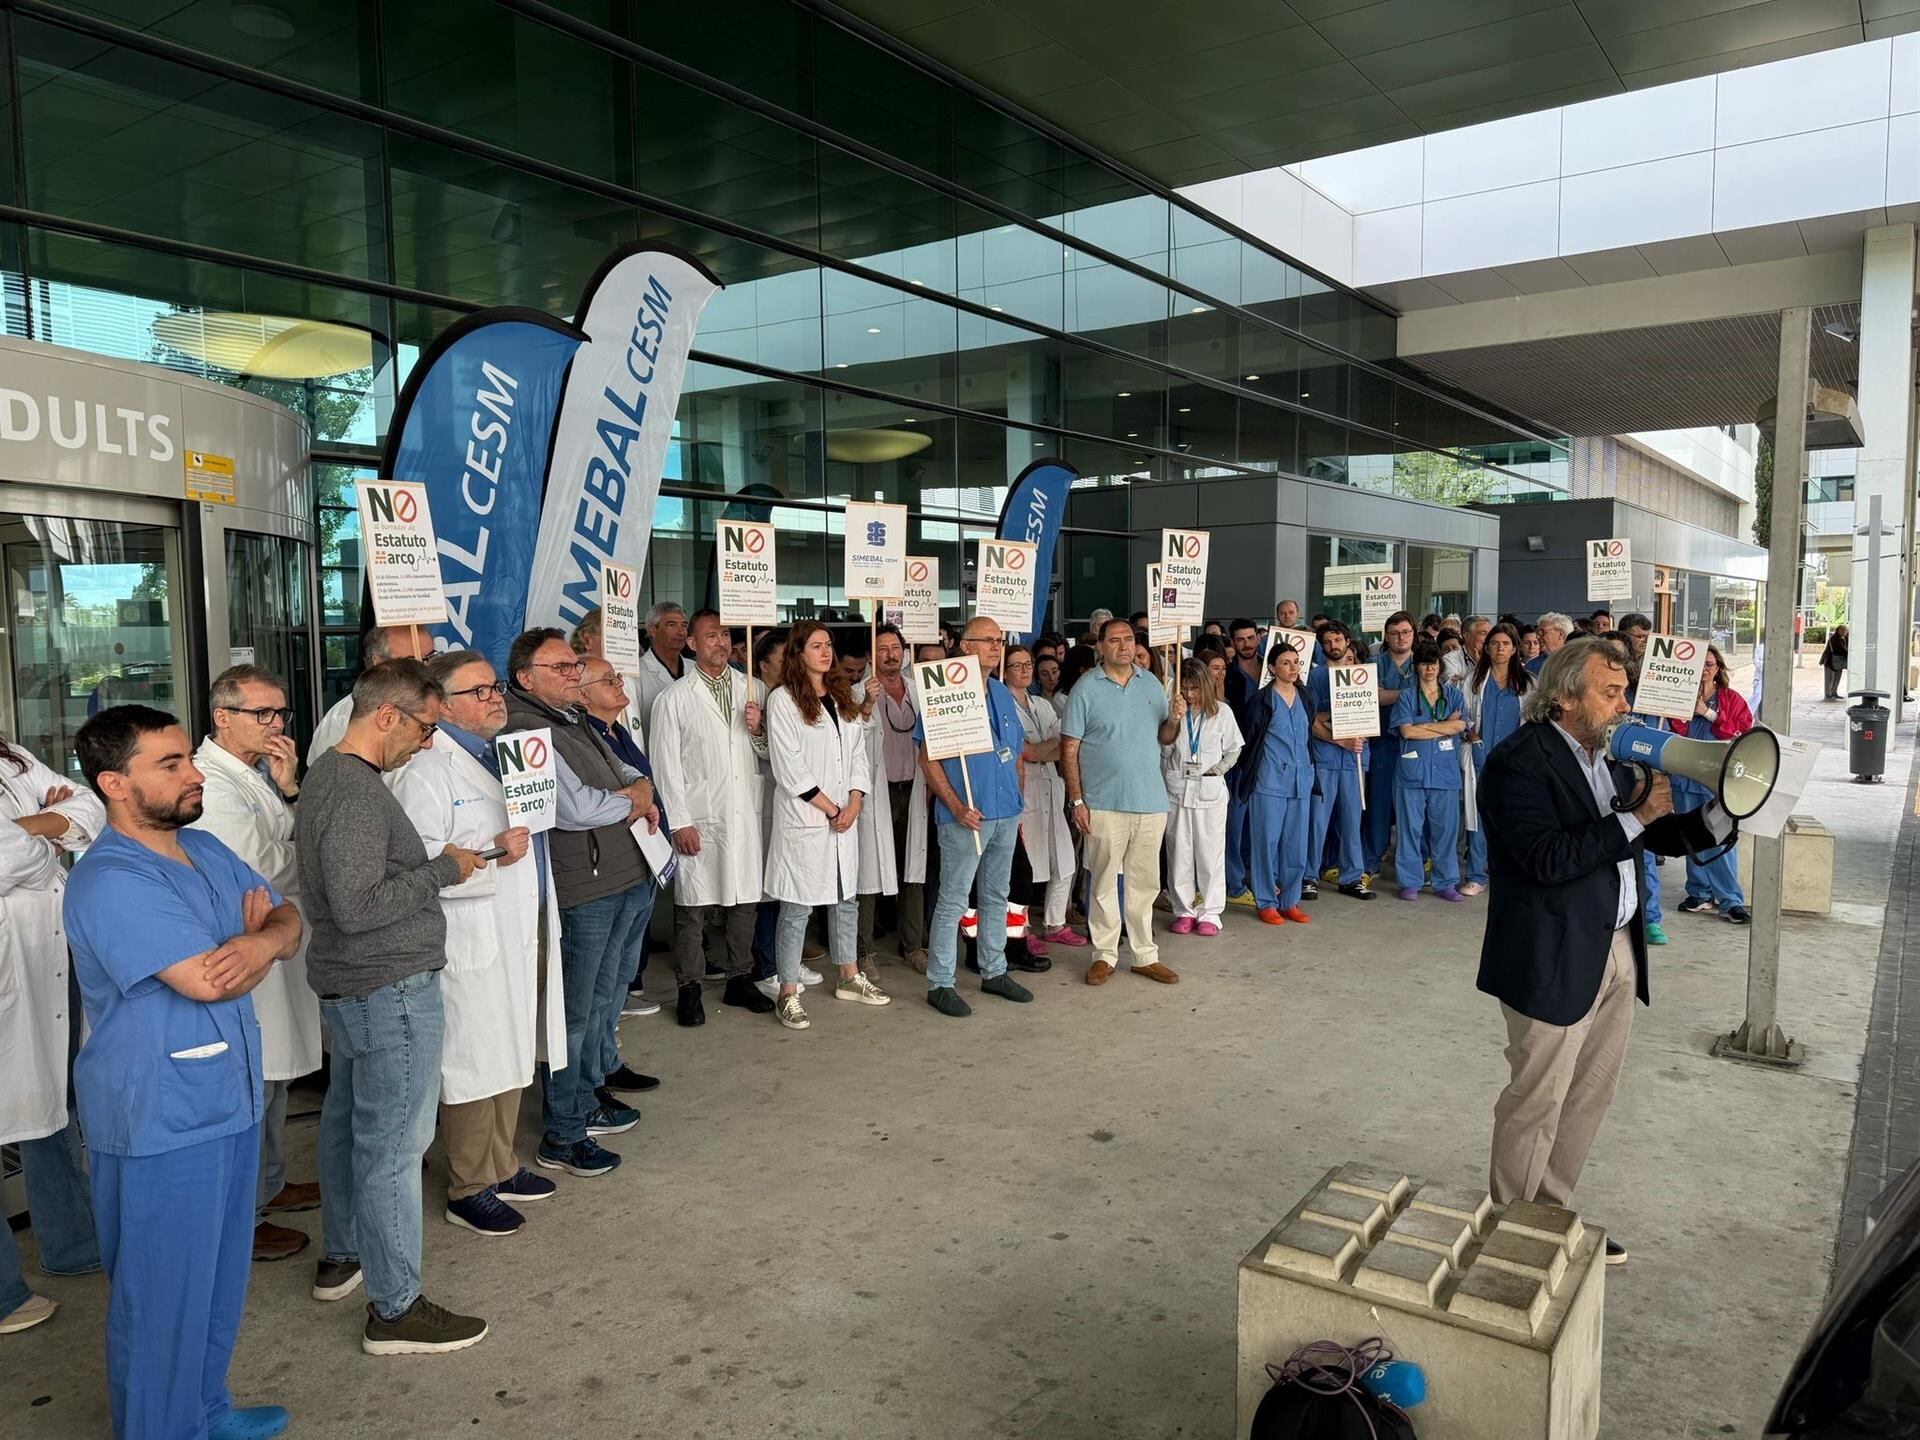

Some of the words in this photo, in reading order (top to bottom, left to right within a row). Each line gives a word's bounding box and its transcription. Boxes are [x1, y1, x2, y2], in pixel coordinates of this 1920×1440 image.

[626, 274, 673, 385] CESM
[462, 361, 518, 516] CESM
[375, 533, 427, 547] Estatuto
[725, 559, 768, 571] Estatuto
[1168, 564, 1201, 575] Estatuto
[984, 574, 1027, 586] Estatuto
[607, 603, 633, 618] Estatuto
[1649, 663, 1694, 676] Estatuto
[926, 691, 976, 706] Estatuto
[1336, 690, 1372, 700] Estatuto
[504, 778, 555, 799] Estatuto
